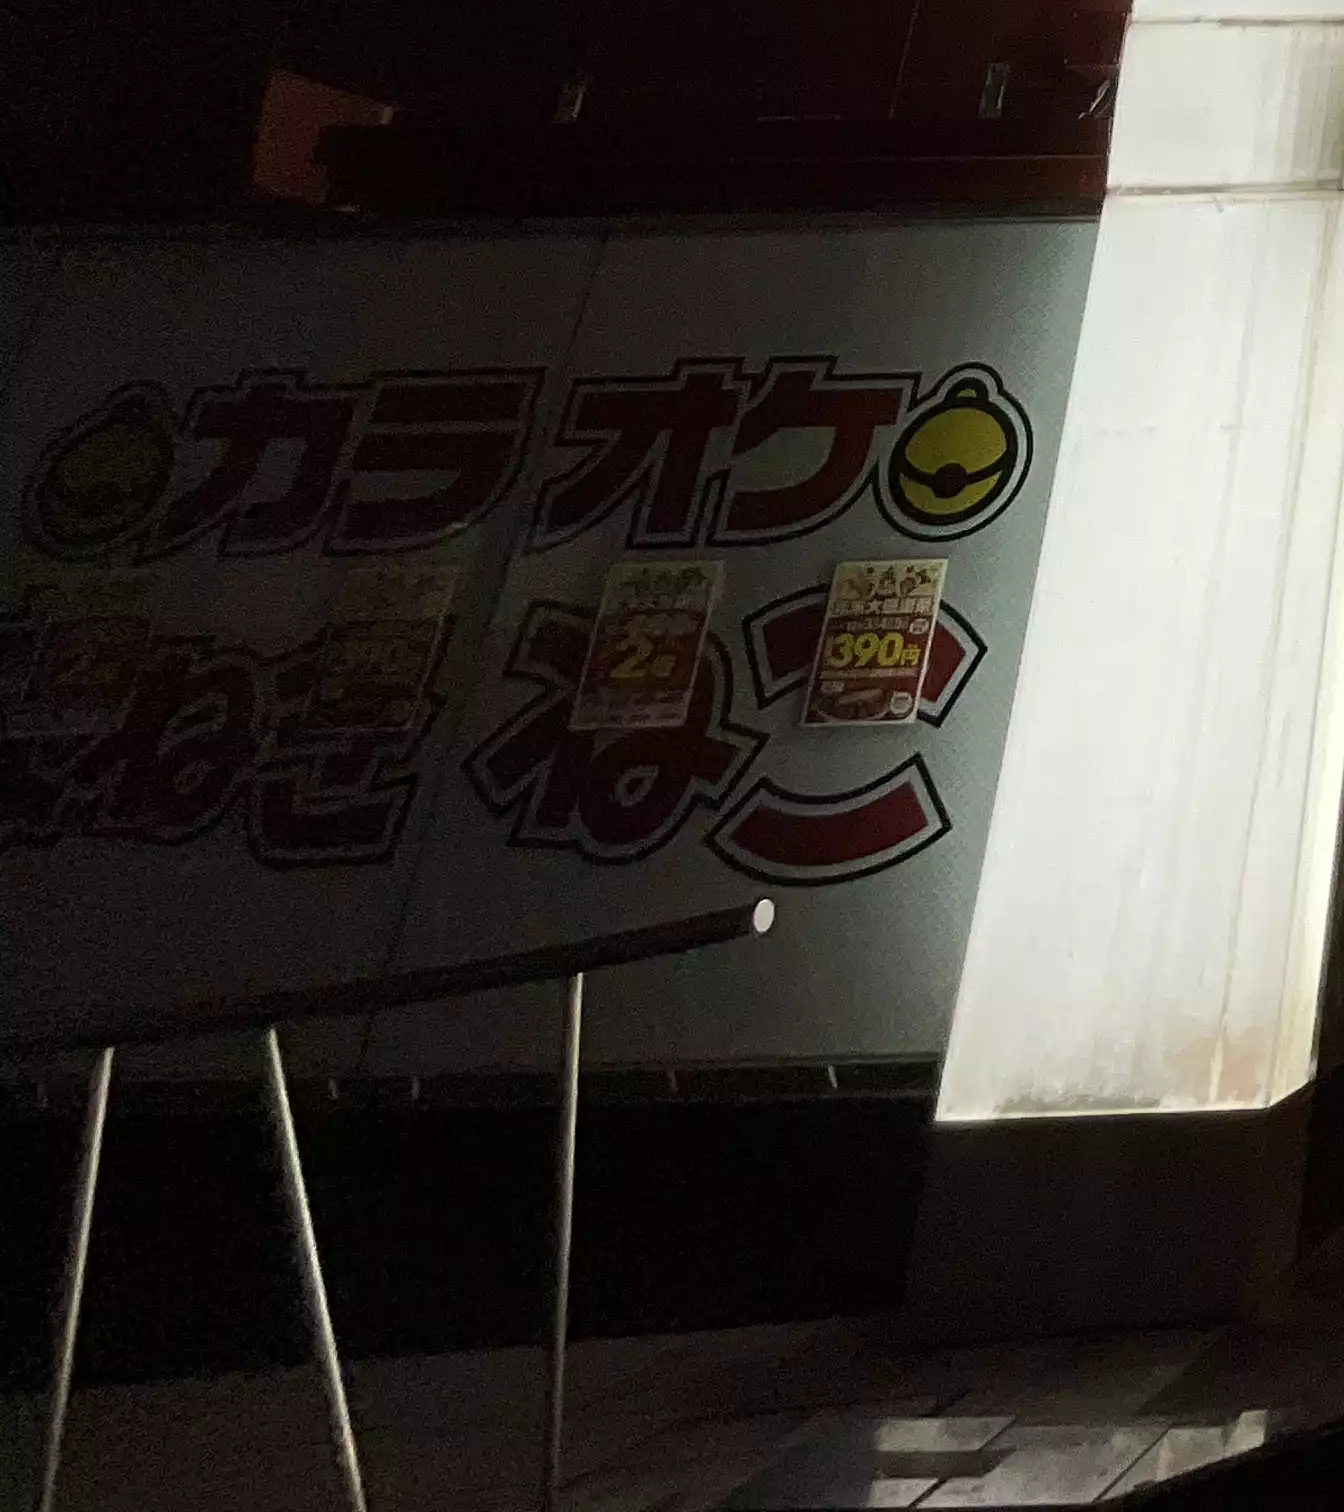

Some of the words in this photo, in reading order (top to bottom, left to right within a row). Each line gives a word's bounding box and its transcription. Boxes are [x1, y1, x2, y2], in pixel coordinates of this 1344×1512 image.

[148, 359, 916, 556] カラオケ
[824, 631, 923, 669] 390円
